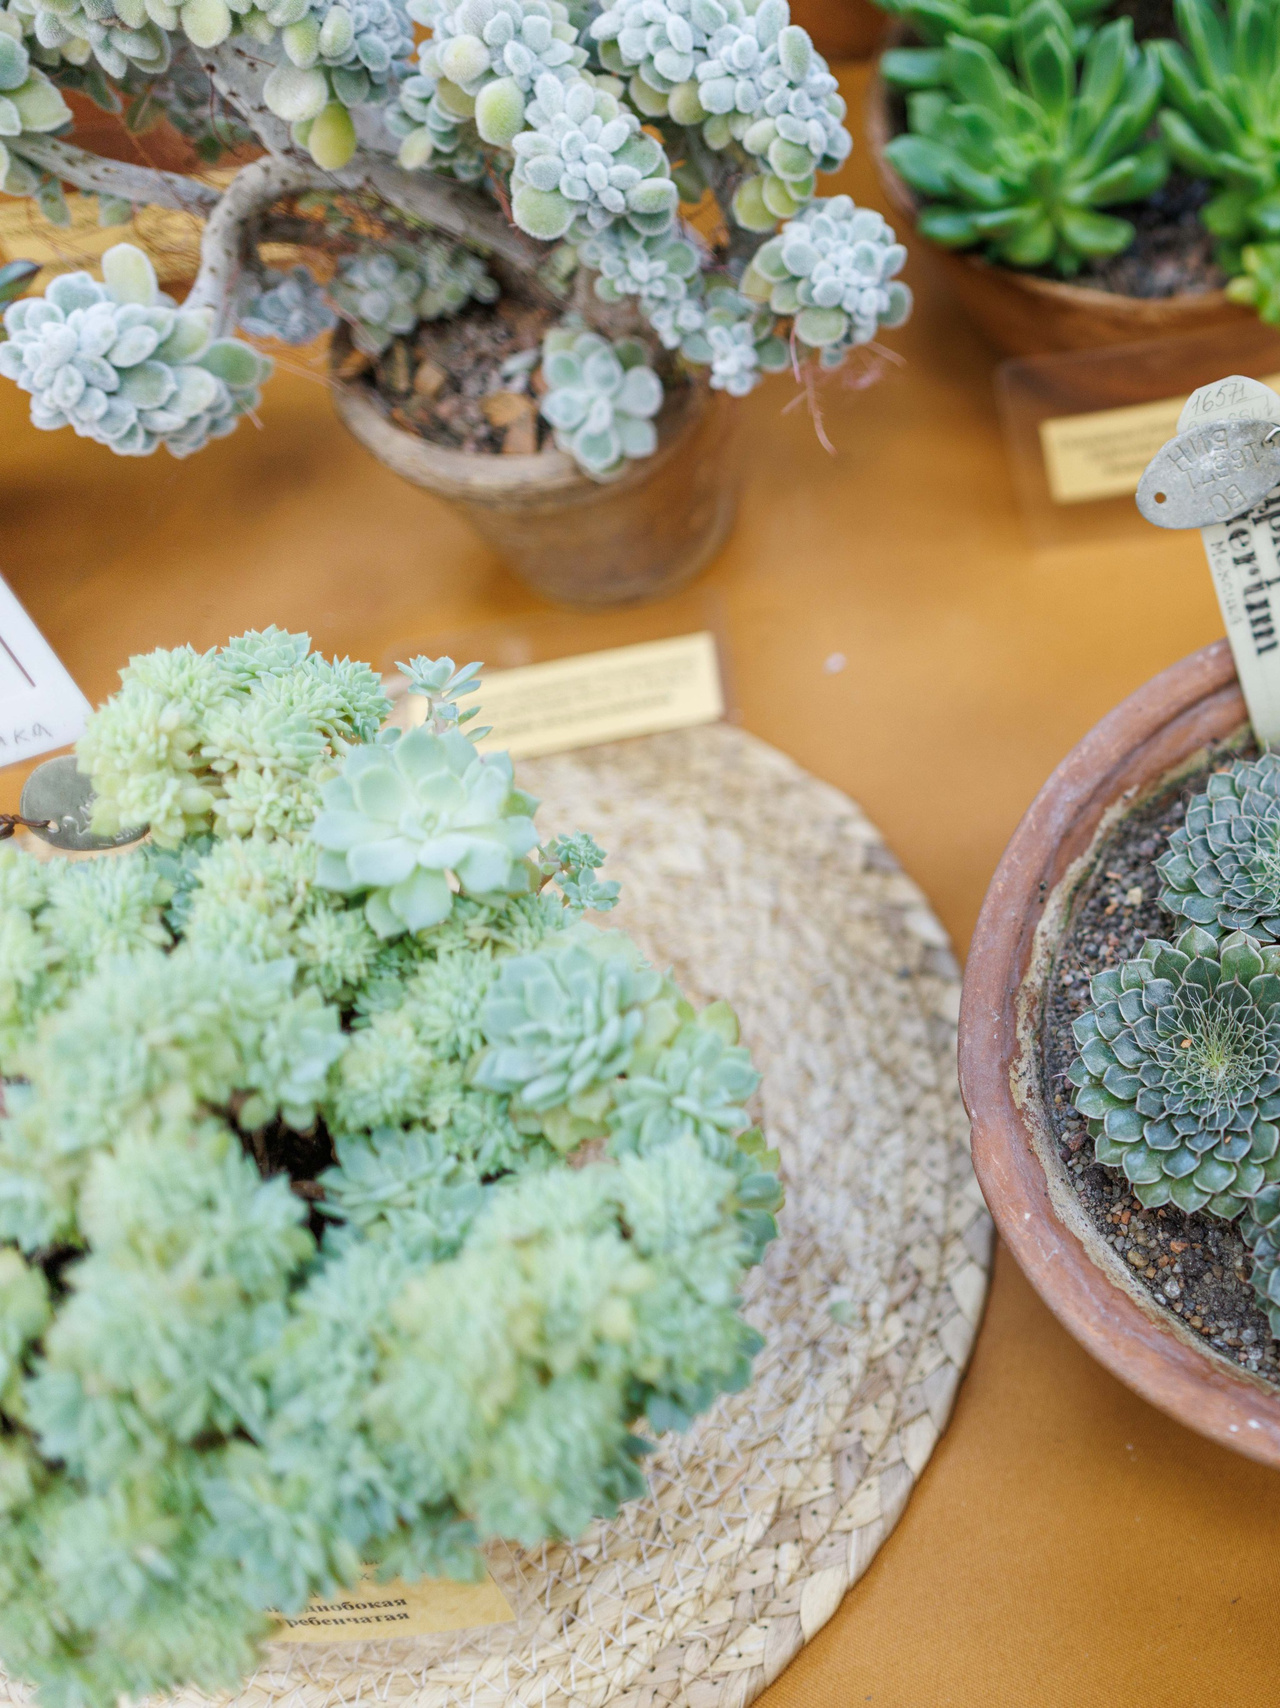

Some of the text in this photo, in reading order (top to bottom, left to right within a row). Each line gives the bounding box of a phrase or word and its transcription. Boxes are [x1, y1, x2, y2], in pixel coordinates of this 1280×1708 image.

[1191, 382, 1247, 415] 16571
[1188, 440, 1264, 493] 16571
[306, 1598, 407, 1614] днобокая
